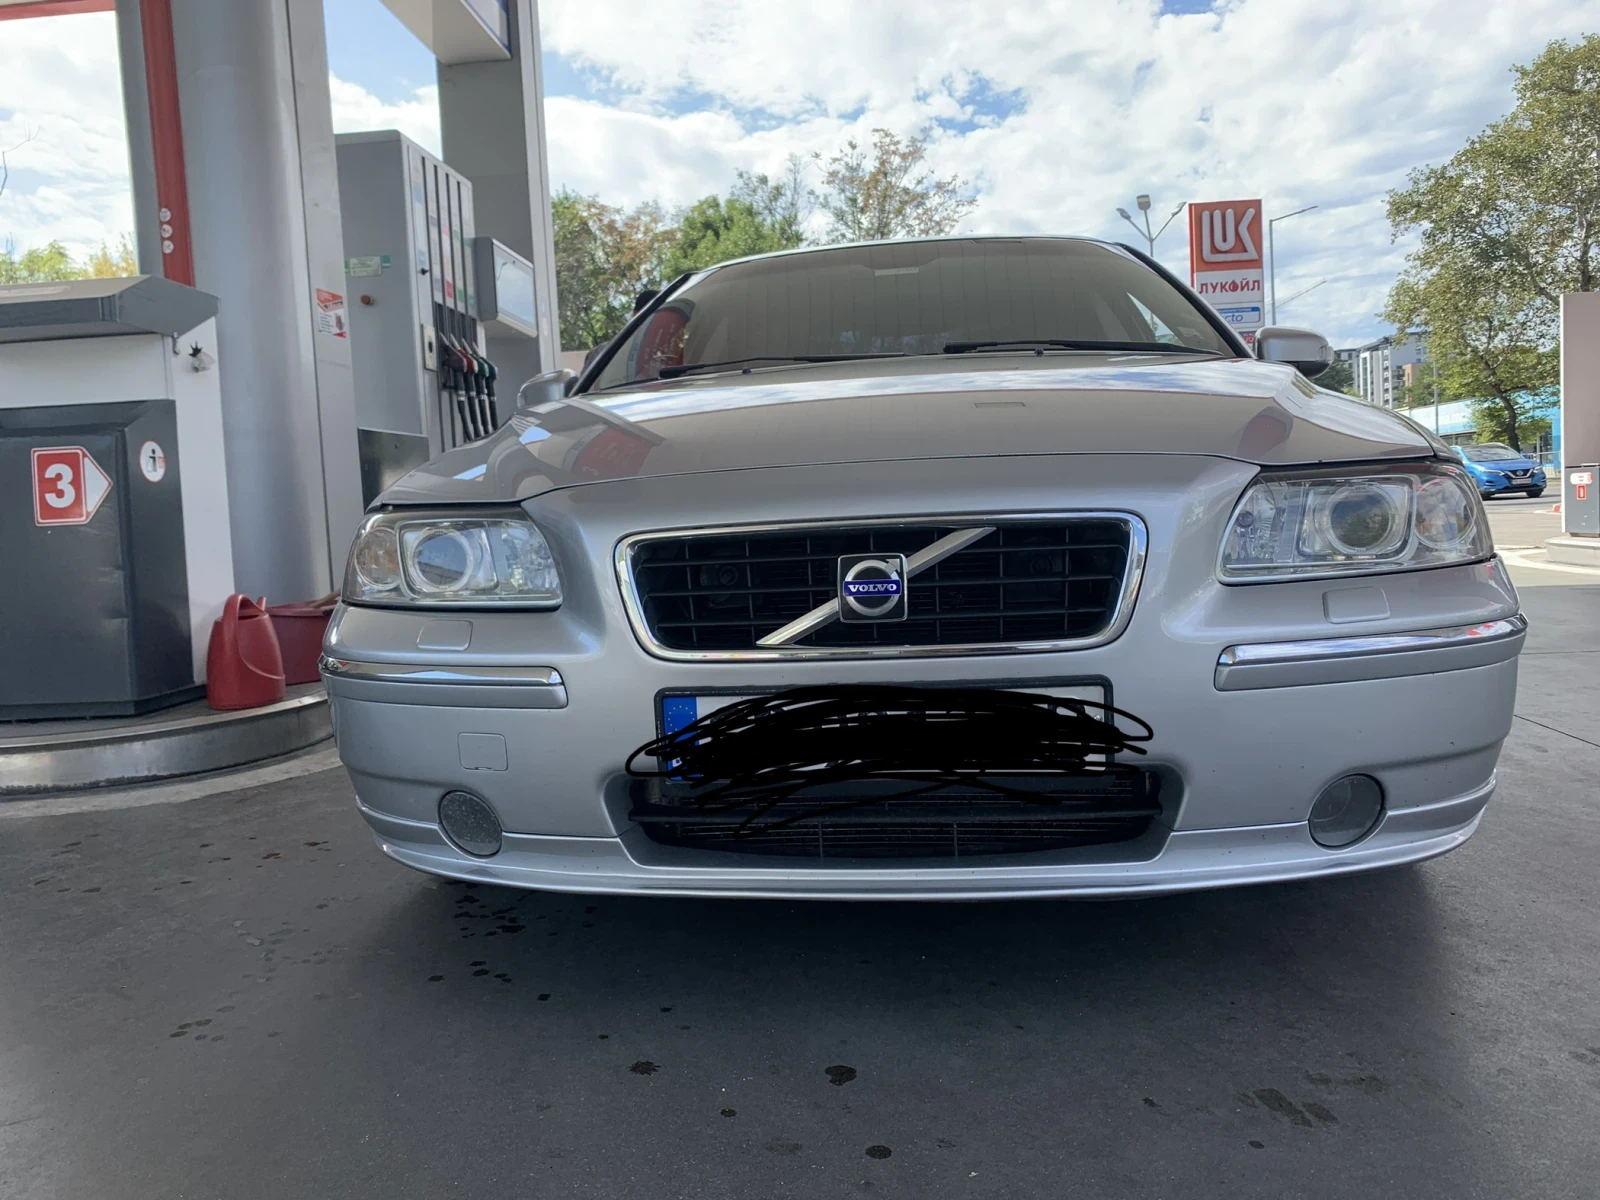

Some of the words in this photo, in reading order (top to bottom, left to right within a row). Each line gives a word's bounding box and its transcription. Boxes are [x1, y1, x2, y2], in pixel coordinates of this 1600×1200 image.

[1202, 208, 1259, 262] LUK
[1199, 278, 1260, 294] ЛУКОЙЛ
[44, 463, 76, 509] 3
[847, 583, 897, 592] VOLVO
